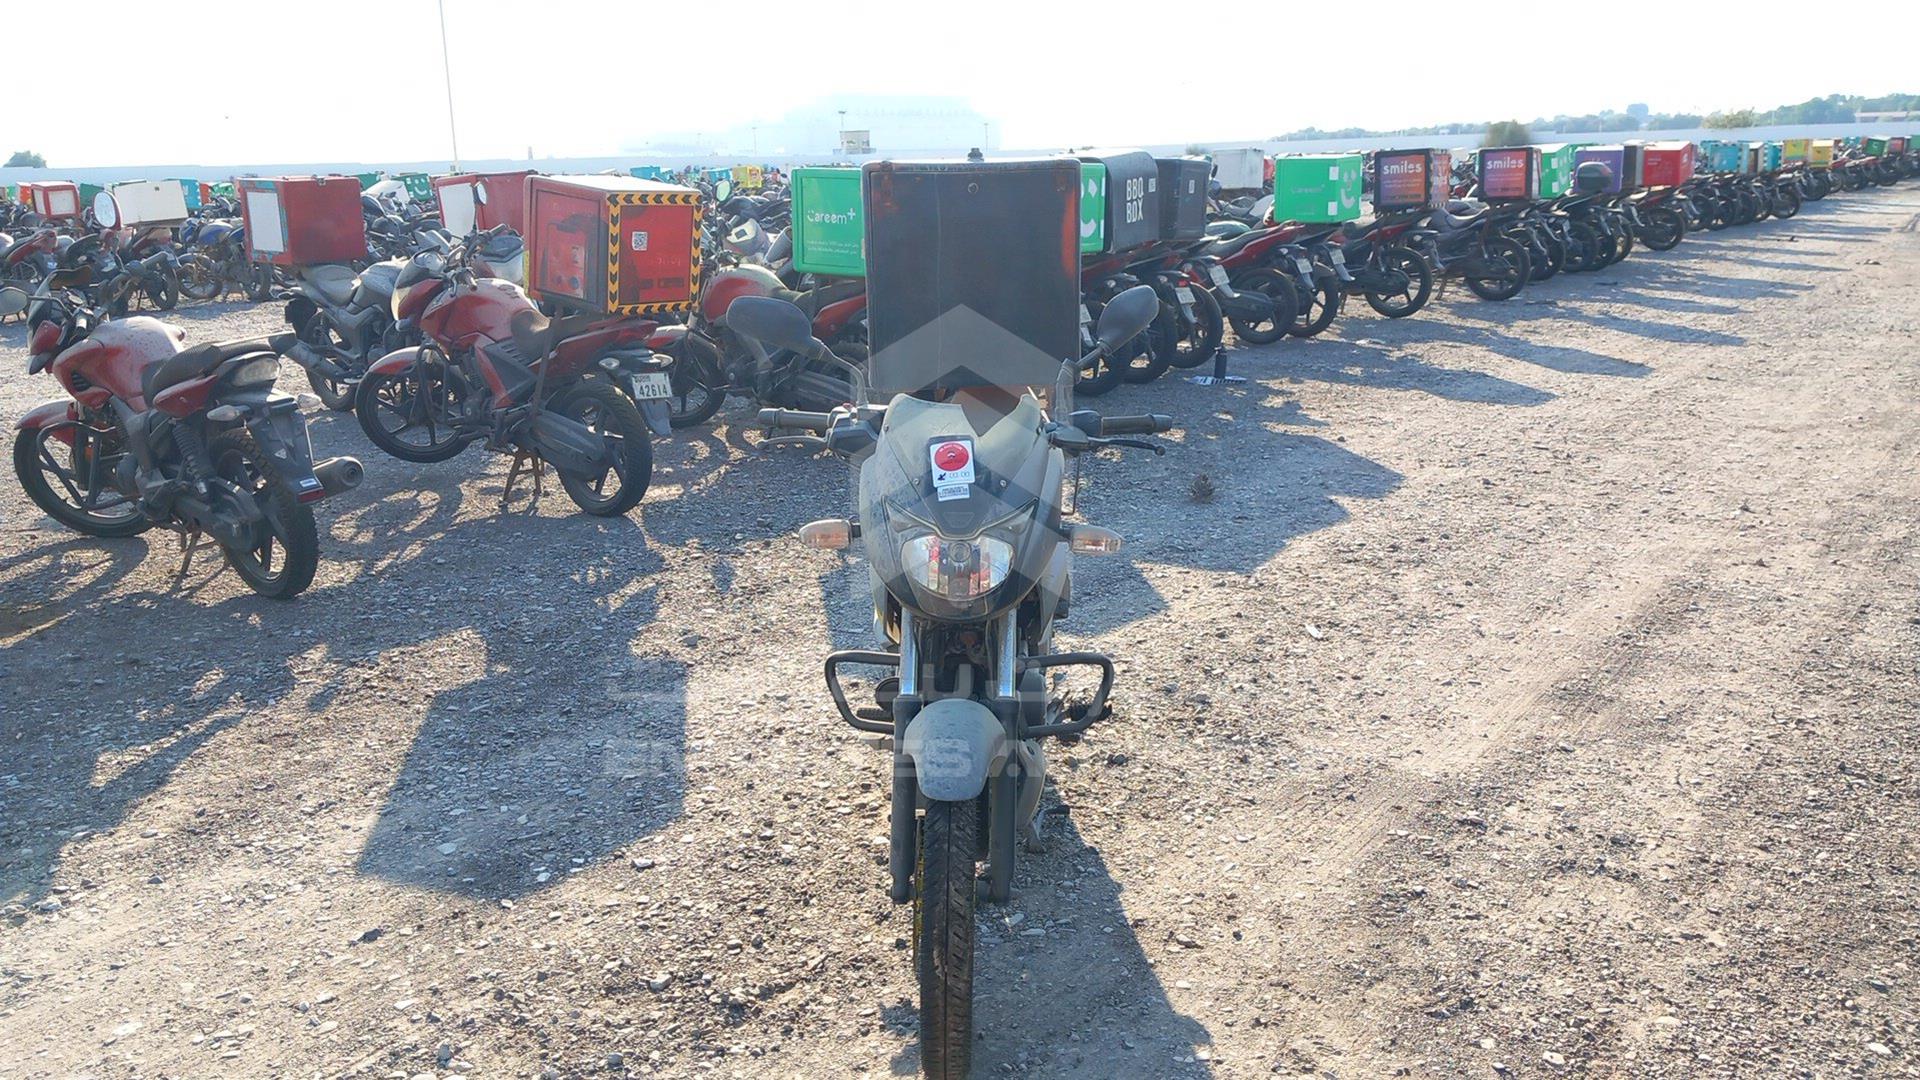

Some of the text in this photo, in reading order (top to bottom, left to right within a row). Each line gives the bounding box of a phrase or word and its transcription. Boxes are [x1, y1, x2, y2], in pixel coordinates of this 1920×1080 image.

[1383, 160, 1423, 175] smiles
[1486, 156, 1524, 170] smiles
[1126, 176, 1144, 201] BBQ
[1126, 199, 1144, 224] BOX
[639, 384, 668, 397] 42614
